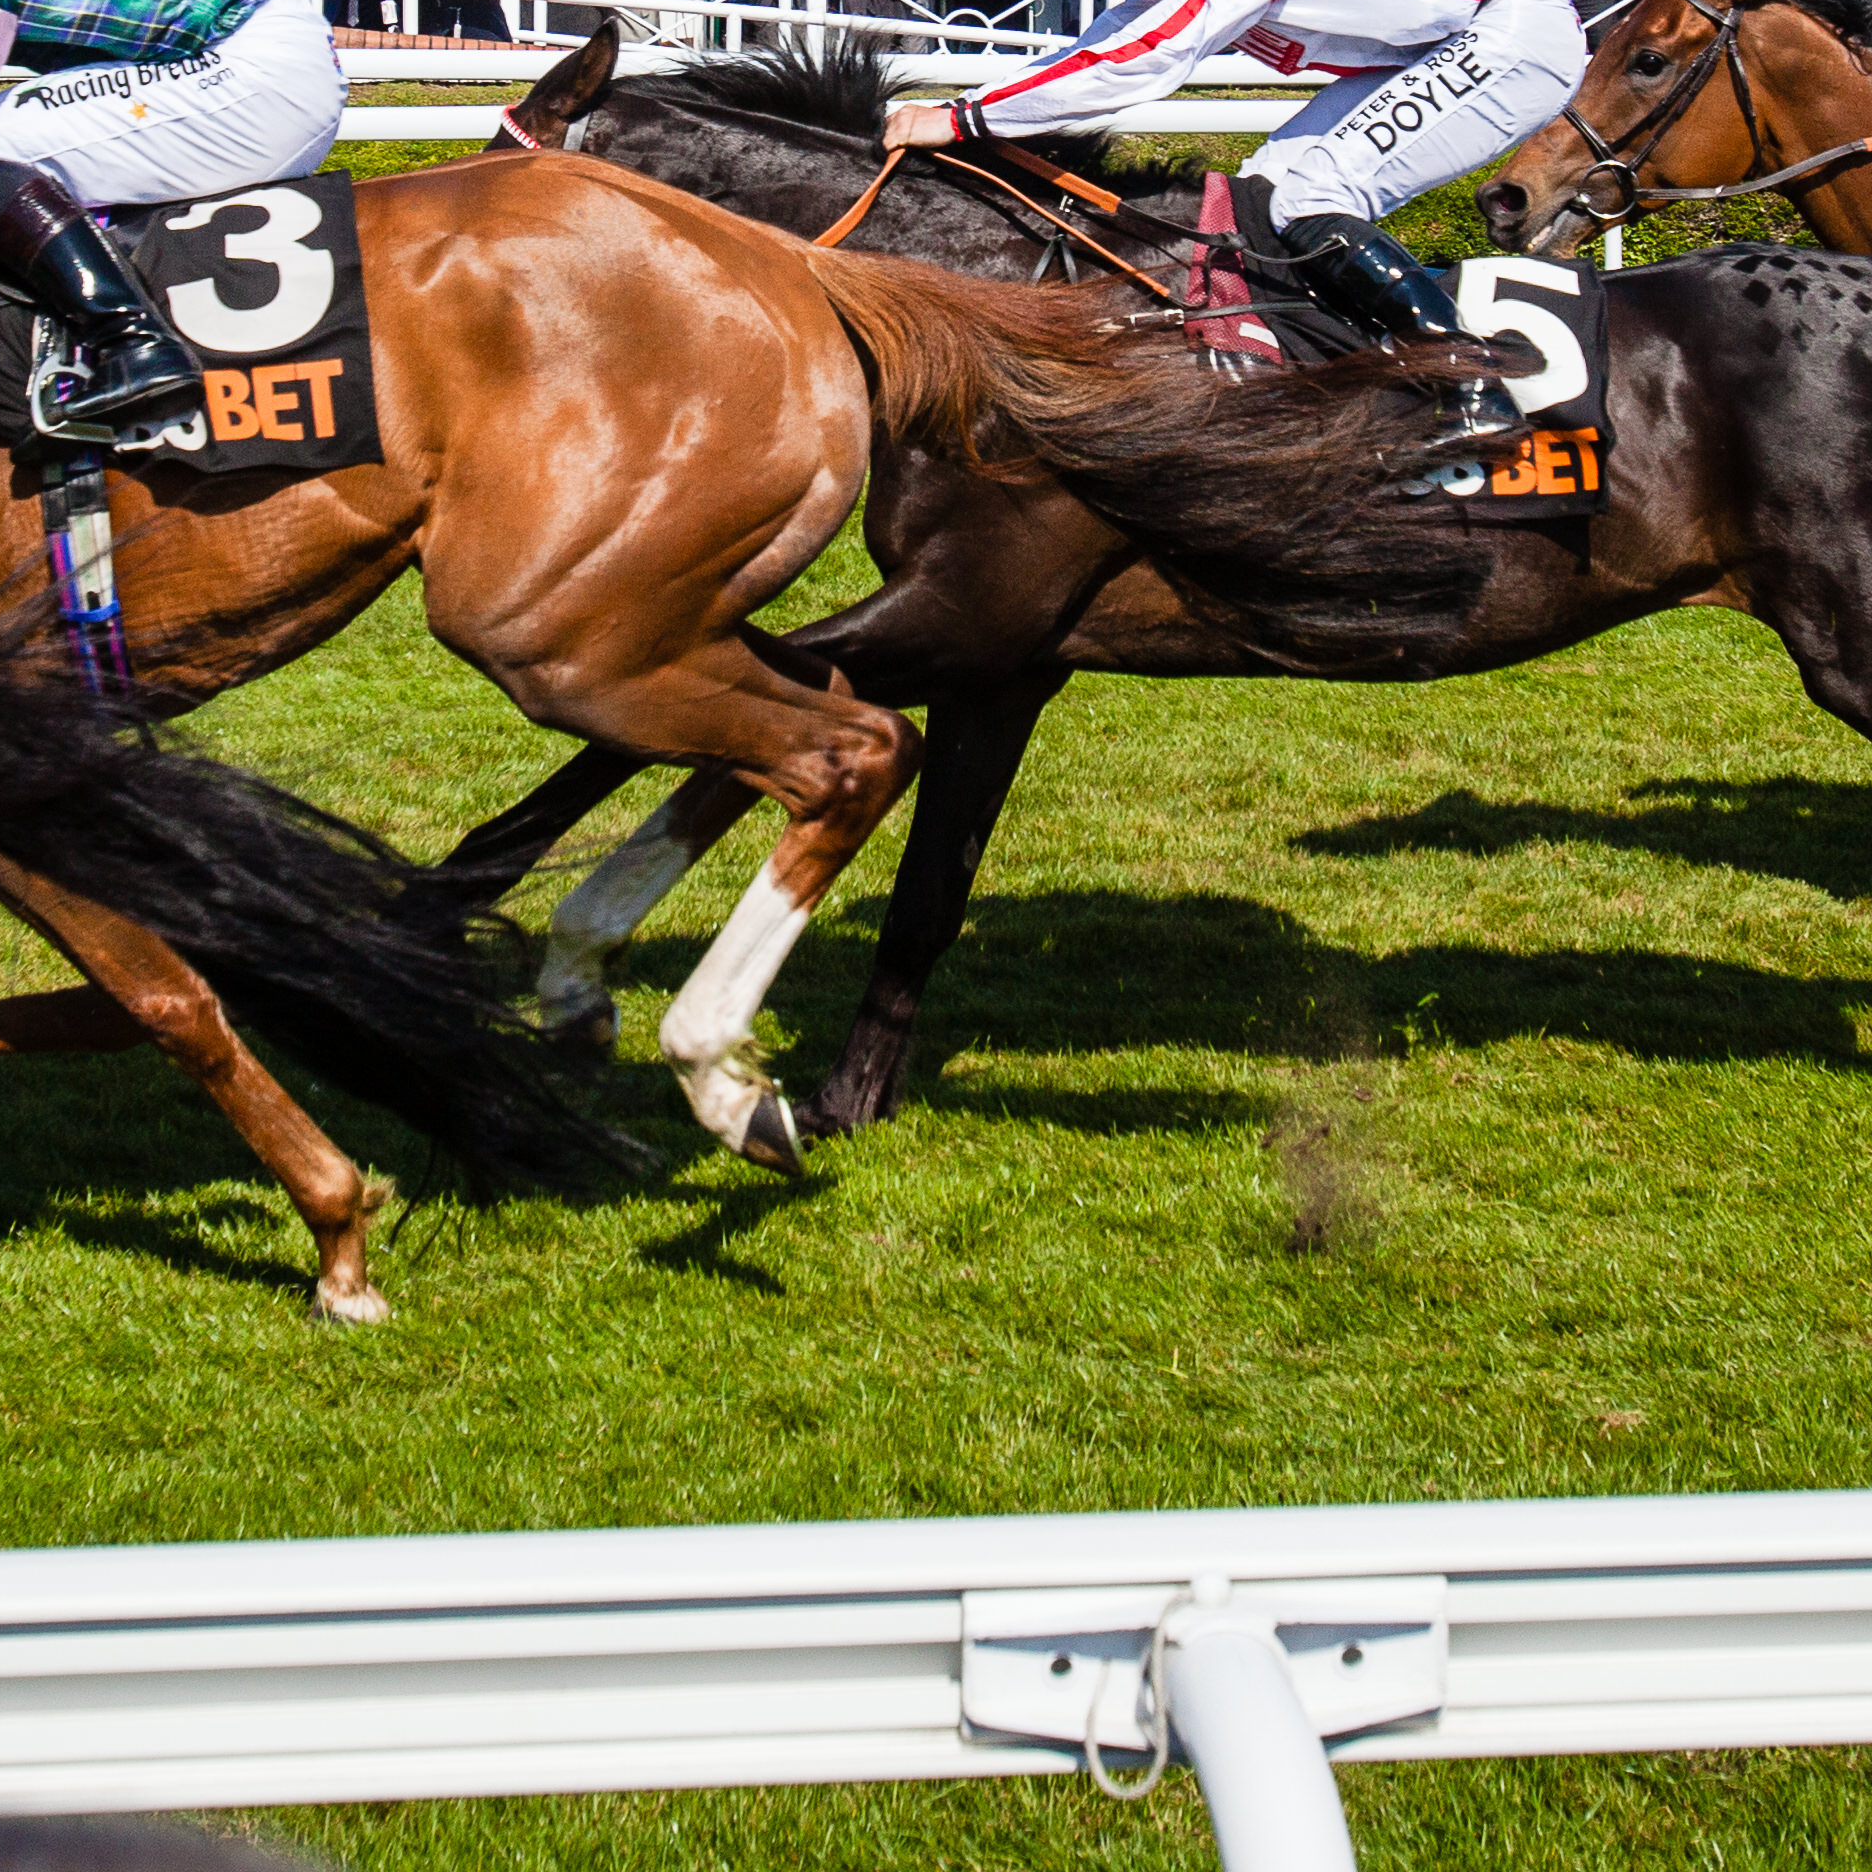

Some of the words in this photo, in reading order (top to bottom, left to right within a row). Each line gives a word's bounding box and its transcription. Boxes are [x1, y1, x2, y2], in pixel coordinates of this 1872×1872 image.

[39, 68, 132, 110] Racing
[1334, 89, 1397, 140] PETER
[1401, 74, 1420, 87] &
[1424, 30, 1479, 71] ROSS
[1363, 51, 1493, 156] DOYLE
[165, 186, 336, 354] 3
[1457, 256, 1589, 415] 5
